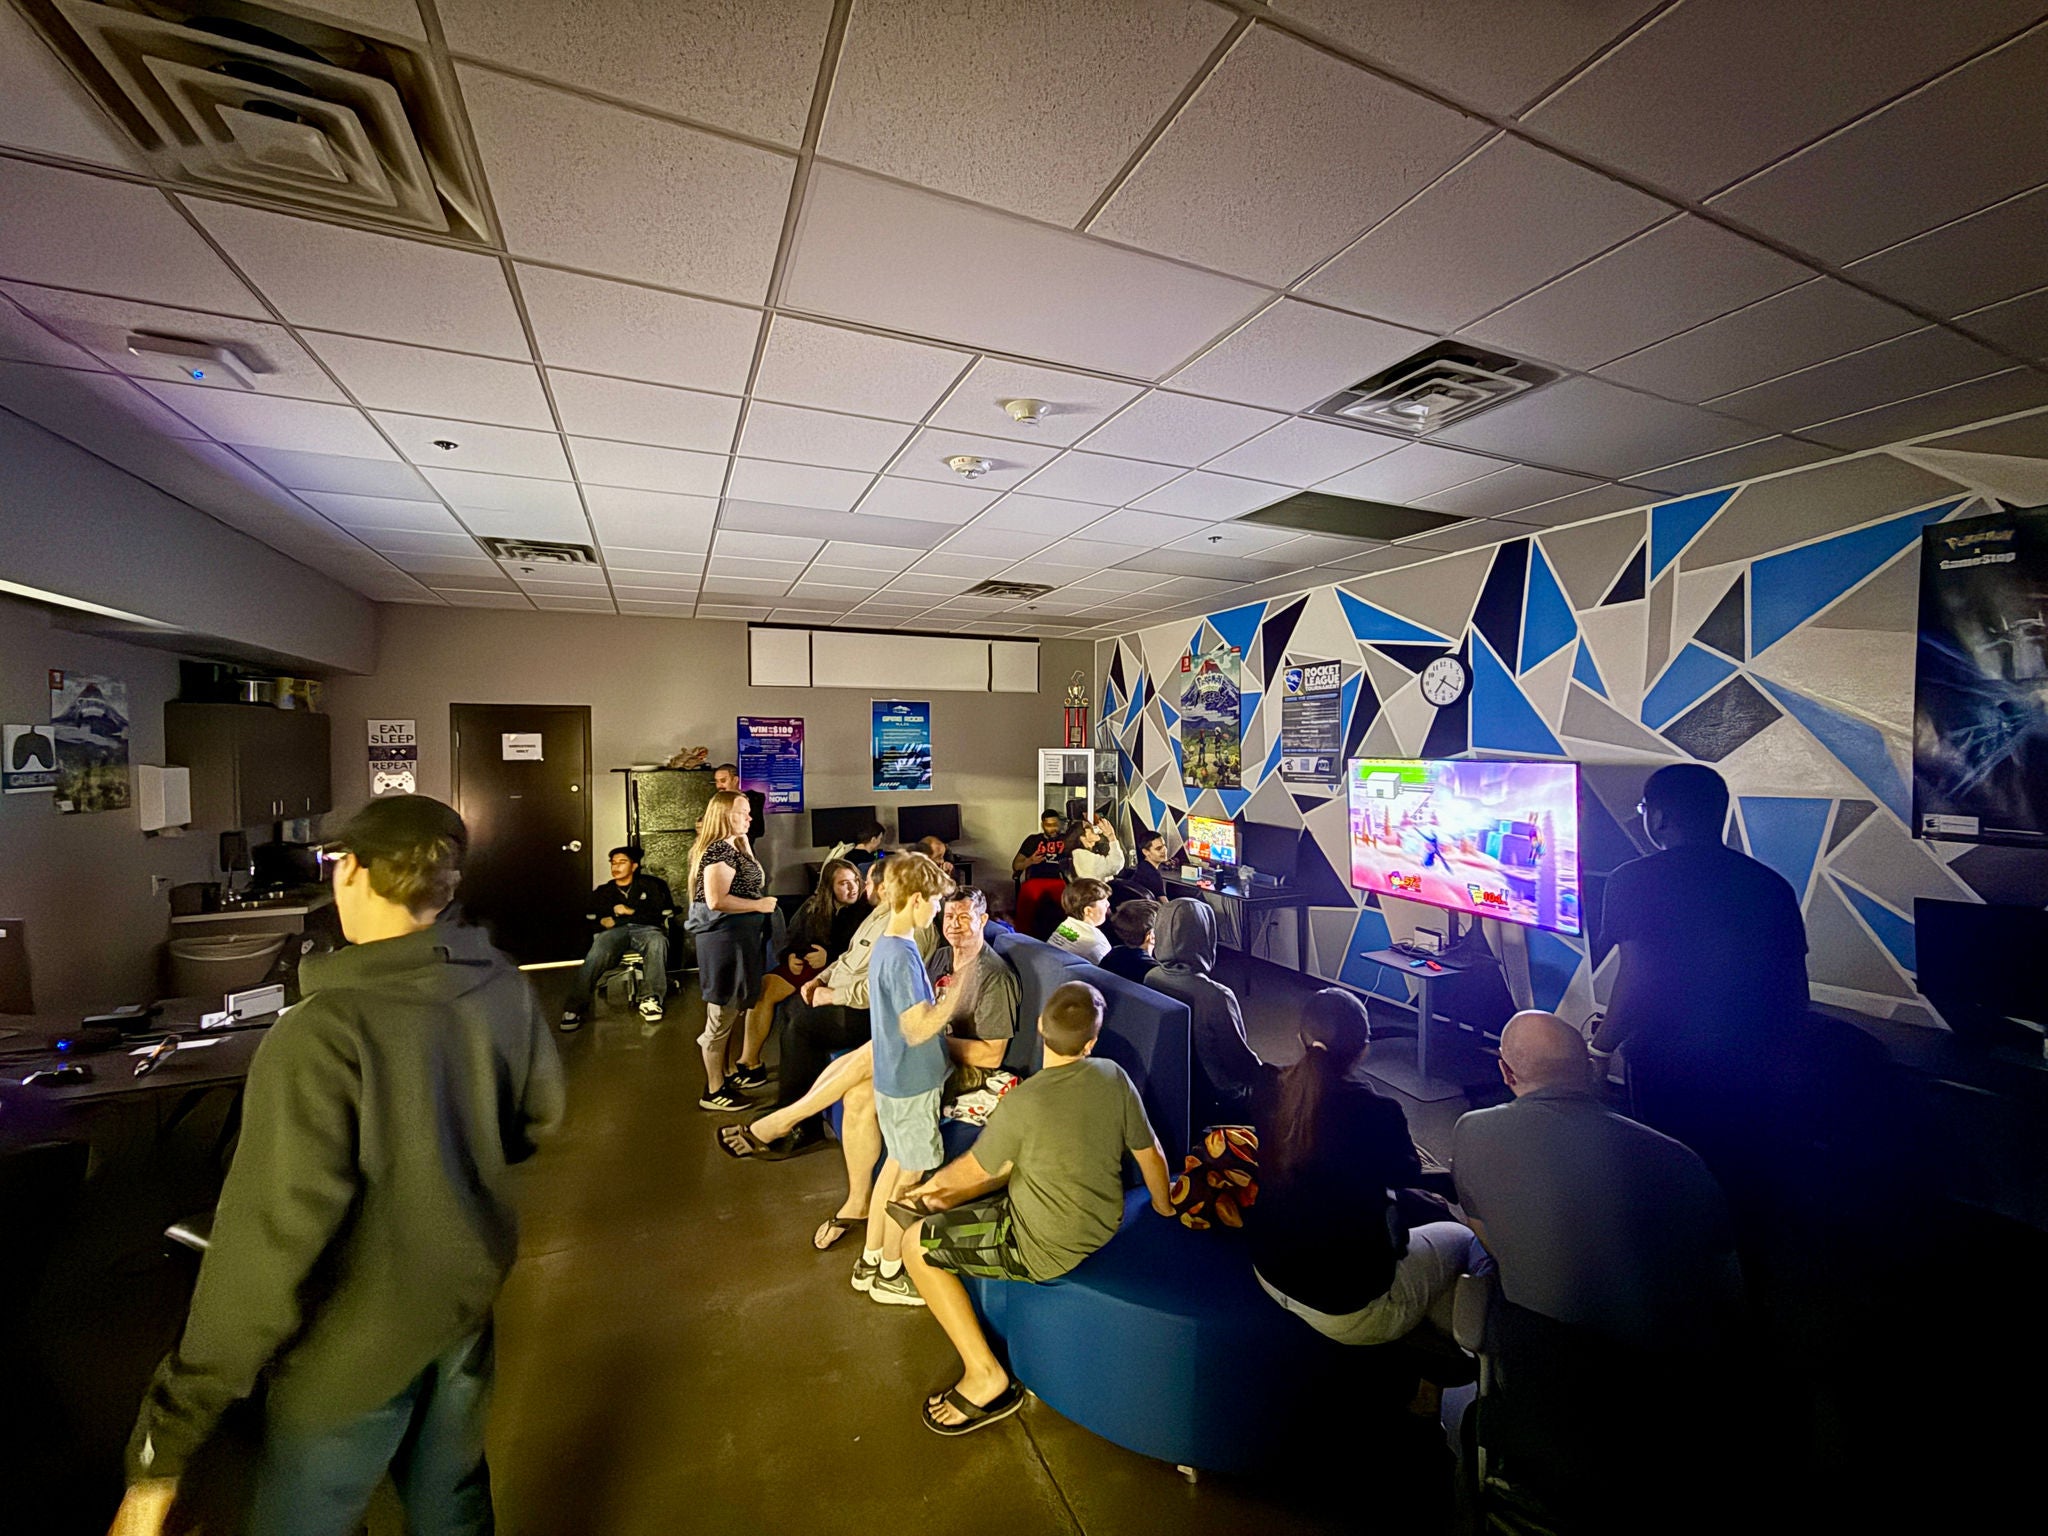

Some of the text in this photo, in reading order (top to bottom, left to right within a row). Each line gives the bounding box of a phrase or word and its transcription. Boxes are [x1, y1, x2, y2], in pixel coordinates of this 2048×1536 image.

[1305, 665, 1340, 677] ROCKET
[1305, 675, 1340, 687] LEAGUE
[379, 724, 405, 734] EAT
[370, 734, 414, 744] SLEEP
